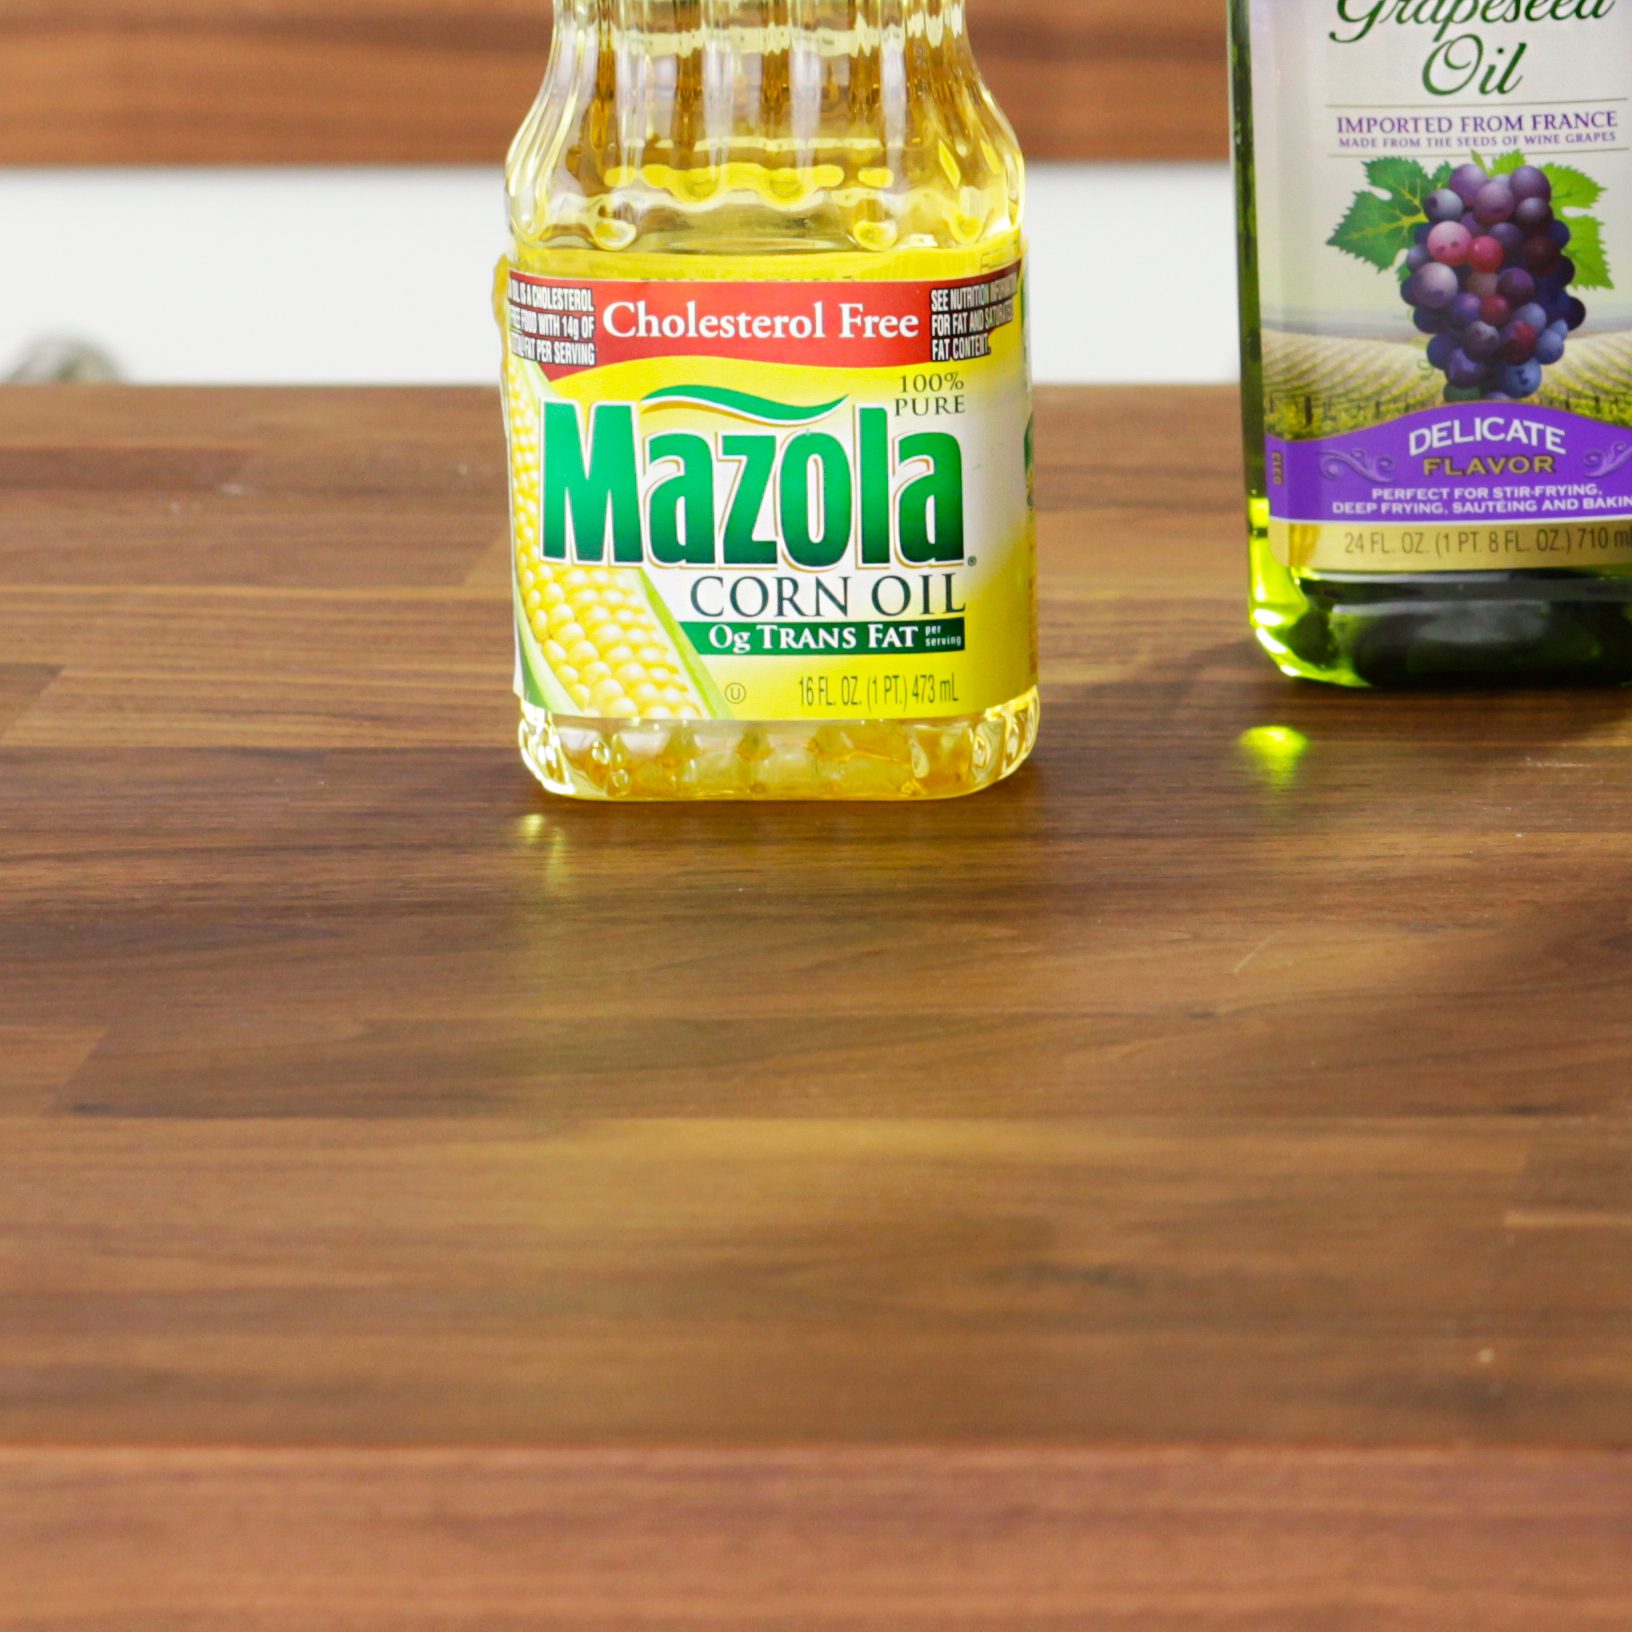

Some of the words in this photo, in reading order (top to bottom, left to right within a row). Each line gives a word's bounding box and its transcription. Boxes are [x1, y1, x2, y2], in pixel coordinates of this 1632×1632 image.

[1422, 32, 1528, 97] Oil
[1337, 116, 1453, 135] IMPORTED
[1460, 114, 1524, 134] FROM
[1531, 110, 1619, 131] FRANCE
[1339, 136, 1378, 148] MADE
[1382, 136, 1421, 147] FROM
[1427, 136, 1452, 147] THE
[1457, 136, 1498, 147] SEEDS
[1502, 135, 1519, 147] OF
[1524, 133, 1561, 145] WINE
[1565, 130, 1617, 143] GRAPES
[603, 300, 827, 339] Cholesterol
[839, 302, 919, 339] Free
[900, 371, 965, 394] 100%
[893, 394, 966, 417] PURE
[1408, 416, 1567, 457] DELICATE
[1422, 454, 1556, 477] FLAVOR
[539, 401, 967, 567] Mazola
[1372, 487, 1450, 500] PERFECT
[1454, 487, 1489, 500] FOR
[1332, 501, 1378, 515] DEEP
[1541, 498, 1580, 512] AND
[1344, 531, 1365, 555] 24
[1370, 531, 1396, 555] FL.
[1401, 531, 1430, 555] OZ.
[1434, 531, 1450, 559] (1
[1488, 531, 1498, 553] 8
[1578, 527, 1609, 550] 710
[690, 575, 852, 618] CORN
[870, 572, 966, 617] OIL
[756, 624, 858, 650] TRANS
[867, 623, 919, 649] FAT
[924, 624, 943, 637] per
[924, 633, 963, 648] serving
[799, 675, 814, 706] 16
[818, 676, 837, 706] FL.
[841, 675, 863, 706] OZ.
[866, 674, 878, 713] (1
[911, 673, 937, 704] 473
[939, 672, 959, 703] mL
